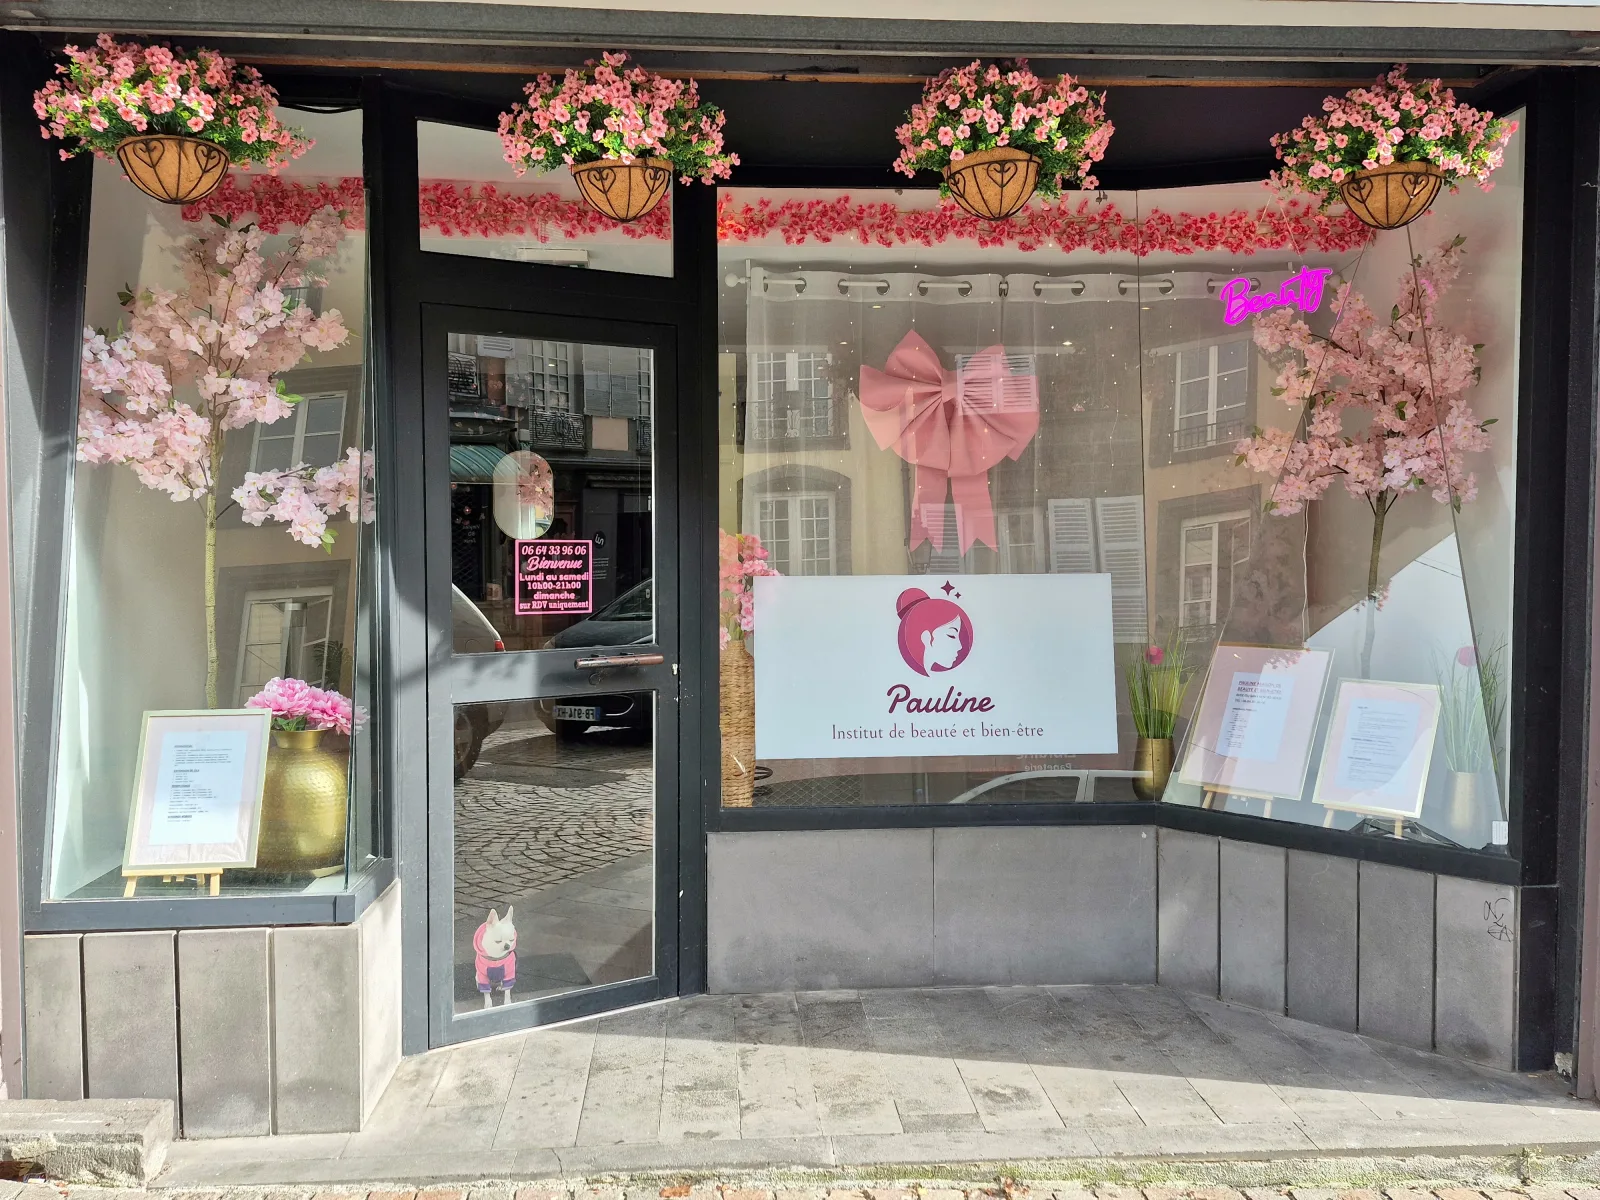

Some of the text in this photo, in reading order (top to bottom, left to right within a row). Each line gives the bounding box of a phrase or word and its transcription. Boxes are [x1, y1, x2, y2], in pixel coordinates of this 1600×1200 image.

[1220, 265, 1333, 326] Beauty
[521, 545, 587, 555] 06 64 33 96 06
[526, 555, 583, 571] Bienvenue
[519, 572, 545, 581] Lundi
[558, 572, 589, 581] samedi
[527, 581, 581, 590] 10h00-21h00
[533, 591, 576, 600] dimanche
[531, 601, 548, 609] RDV
[548, 600, 589, 611] uniquement
[886, 683, 996, 714] Pauline
[832, 722, 1044, 740] Institut de beauté et bien-être
